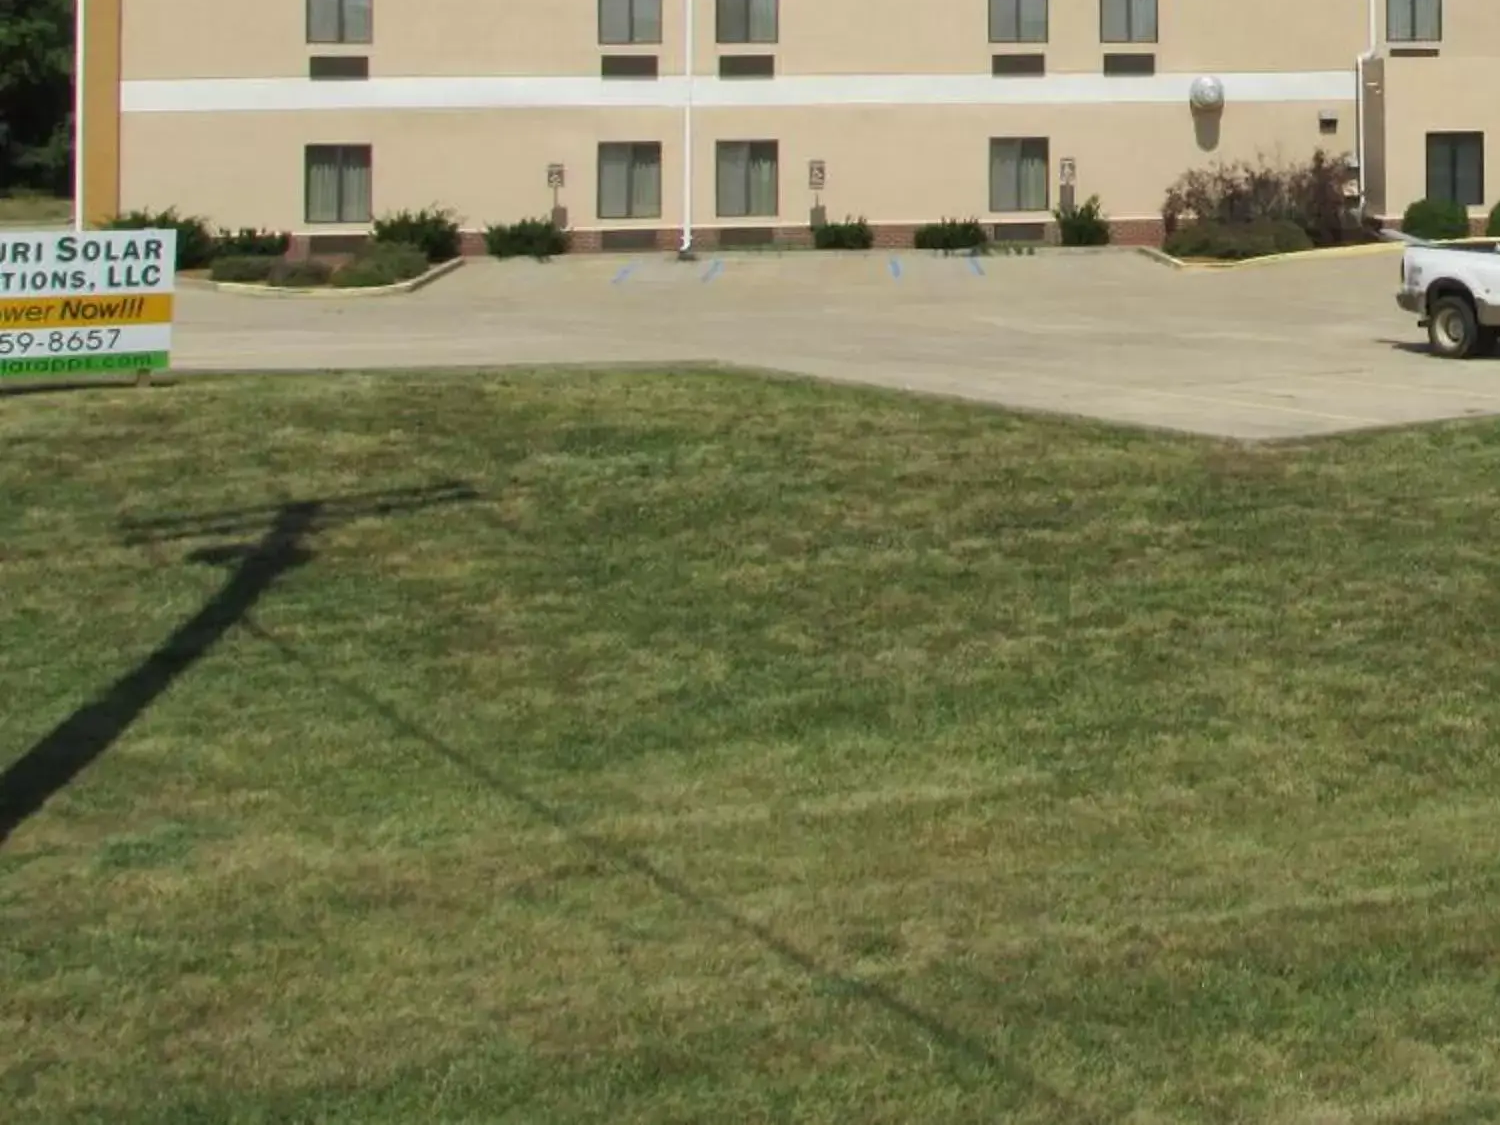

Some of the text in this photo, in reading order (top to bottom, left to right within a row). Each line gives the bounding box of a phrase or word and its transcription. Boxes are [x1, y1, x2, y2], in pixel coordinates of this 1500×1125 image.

[56, 236, 163, 263] SOLAR
[107, 265, 161, 287] LLC
[0, 296, 145, 322] wer Now!!!
[0, 329, 121, 355] 59-8657
